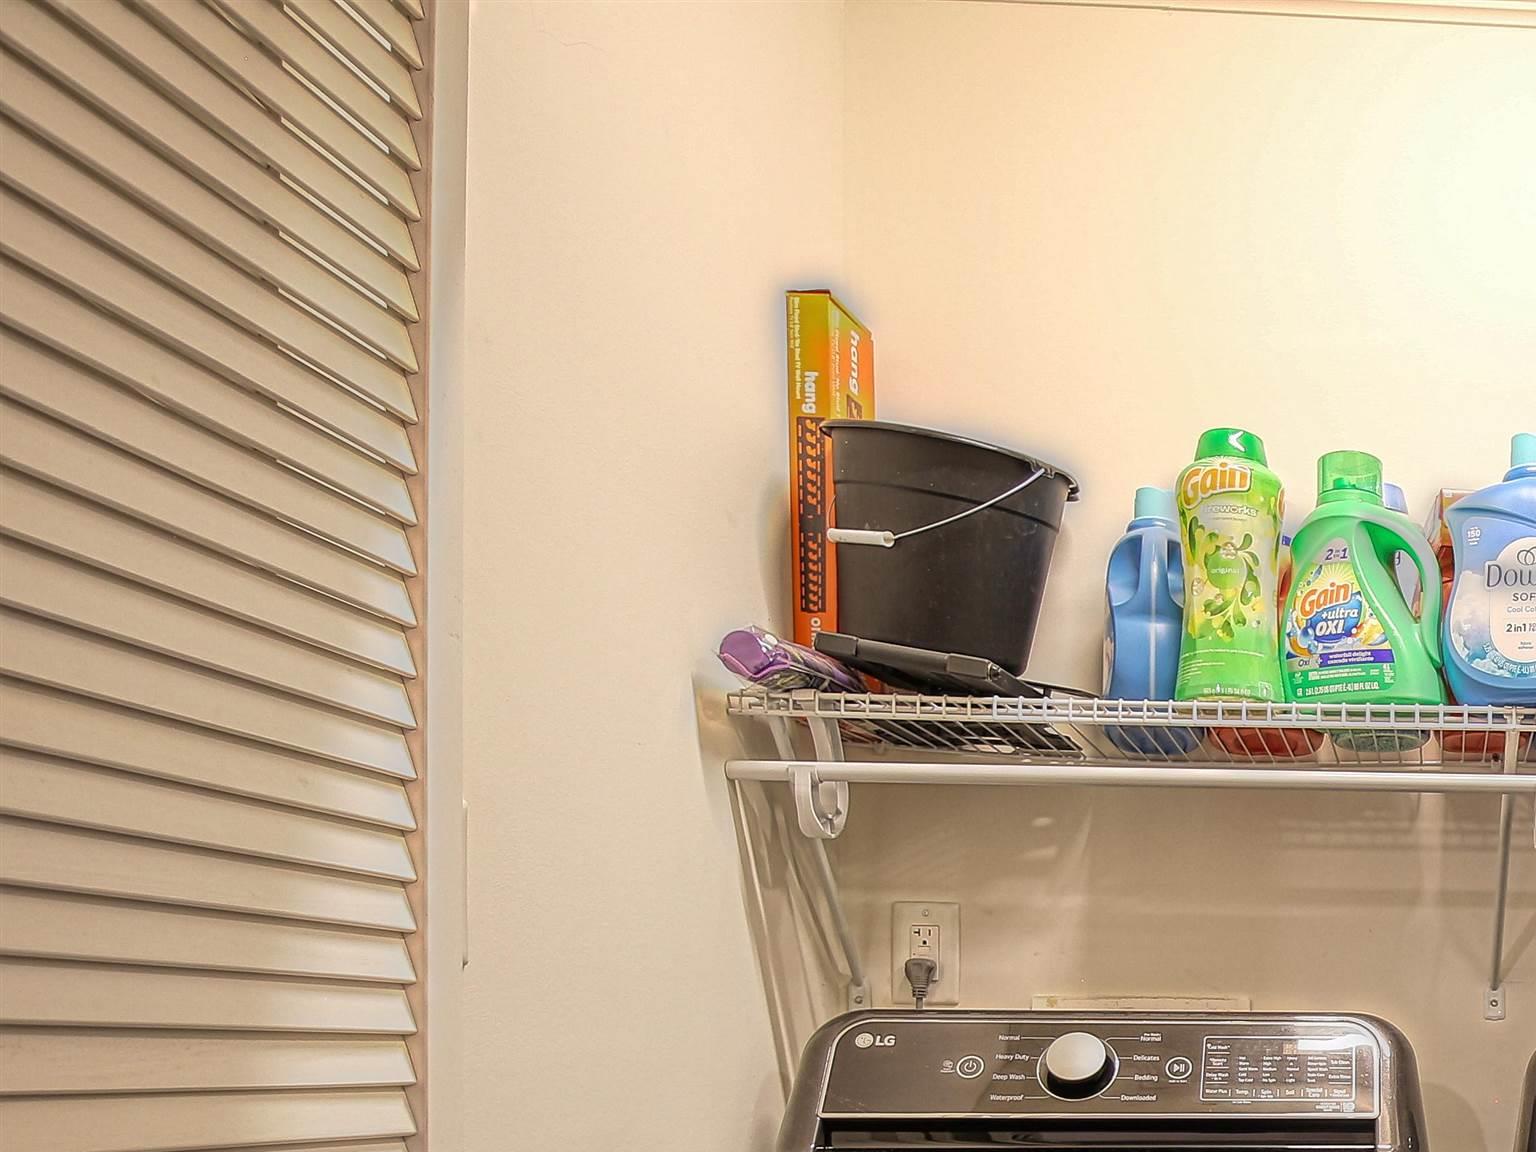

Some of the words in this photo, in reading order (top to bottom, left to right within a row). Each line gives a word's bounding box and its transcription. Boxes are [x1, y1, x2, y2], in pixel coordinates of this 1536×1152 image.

[850, 330, 861, 395] hang
[800, 371, 820, 415] hang
[1182, 462, 1250, 507] Gain
[1467, 529, 1481, 539] 150
[1300, 581, 1352, 618] Gain
[1321, 607, 1359, 621] +ultra
[1506, 605, 1524, 614] Cool
[875, 1035, 896, 1047] LG
[1014, 1053, 1030, 1062] Duty
[992, 1073, 1009, 1081] Deep
[1134, 1074, 1159, 1082] Bedding
[990, 1094, 1025, 1102] Waterproof
